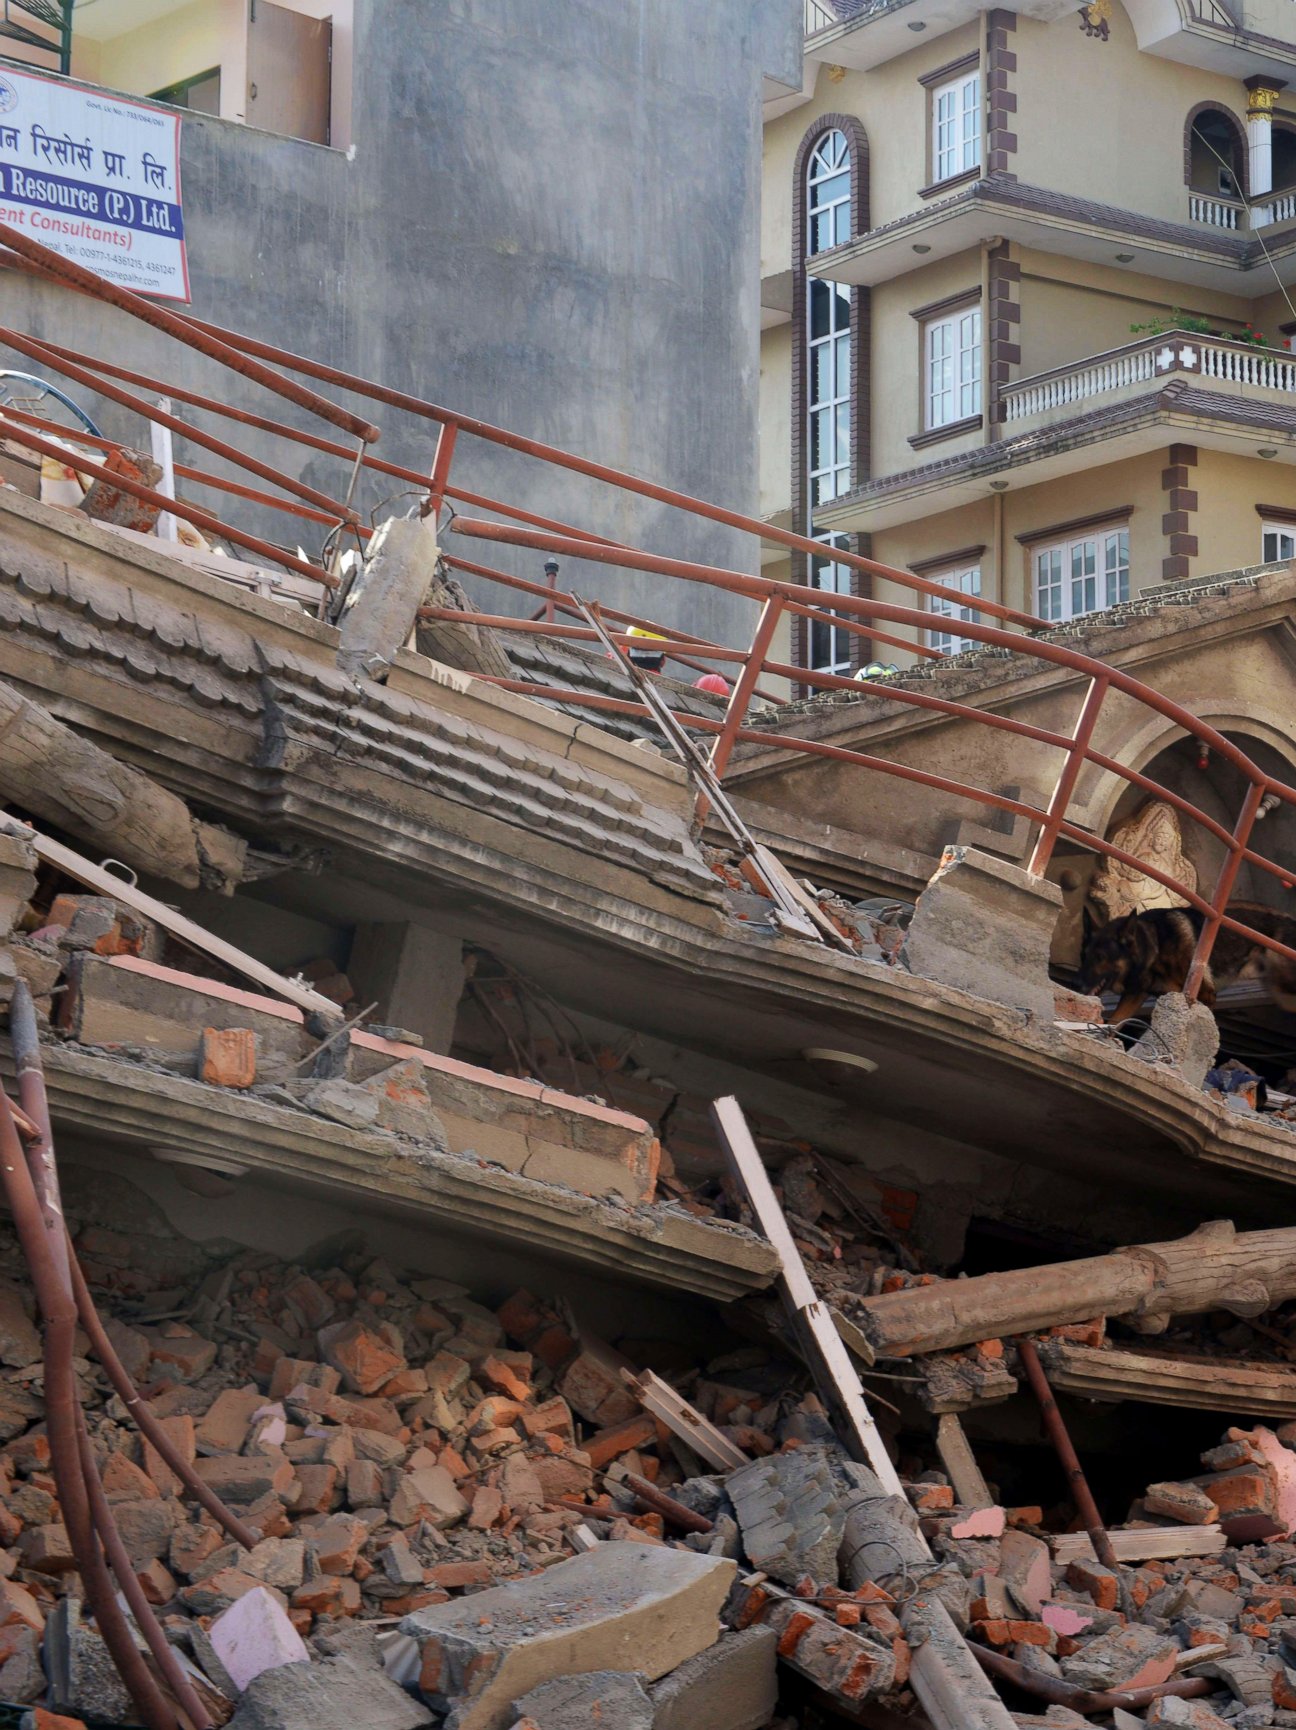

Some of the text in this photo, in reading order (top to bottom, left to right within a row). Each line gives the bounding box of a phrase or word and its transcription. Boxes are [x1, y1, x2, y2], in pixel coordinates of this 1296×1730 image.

[30, 123, 94, 171] रिसोर्स
[10, 167, 99, 214] Resource
[104, 189, 135, 225] (P.)
[141, 197, 176, 232] Ltd.
[30, 210, 133, 250] Consultants)
